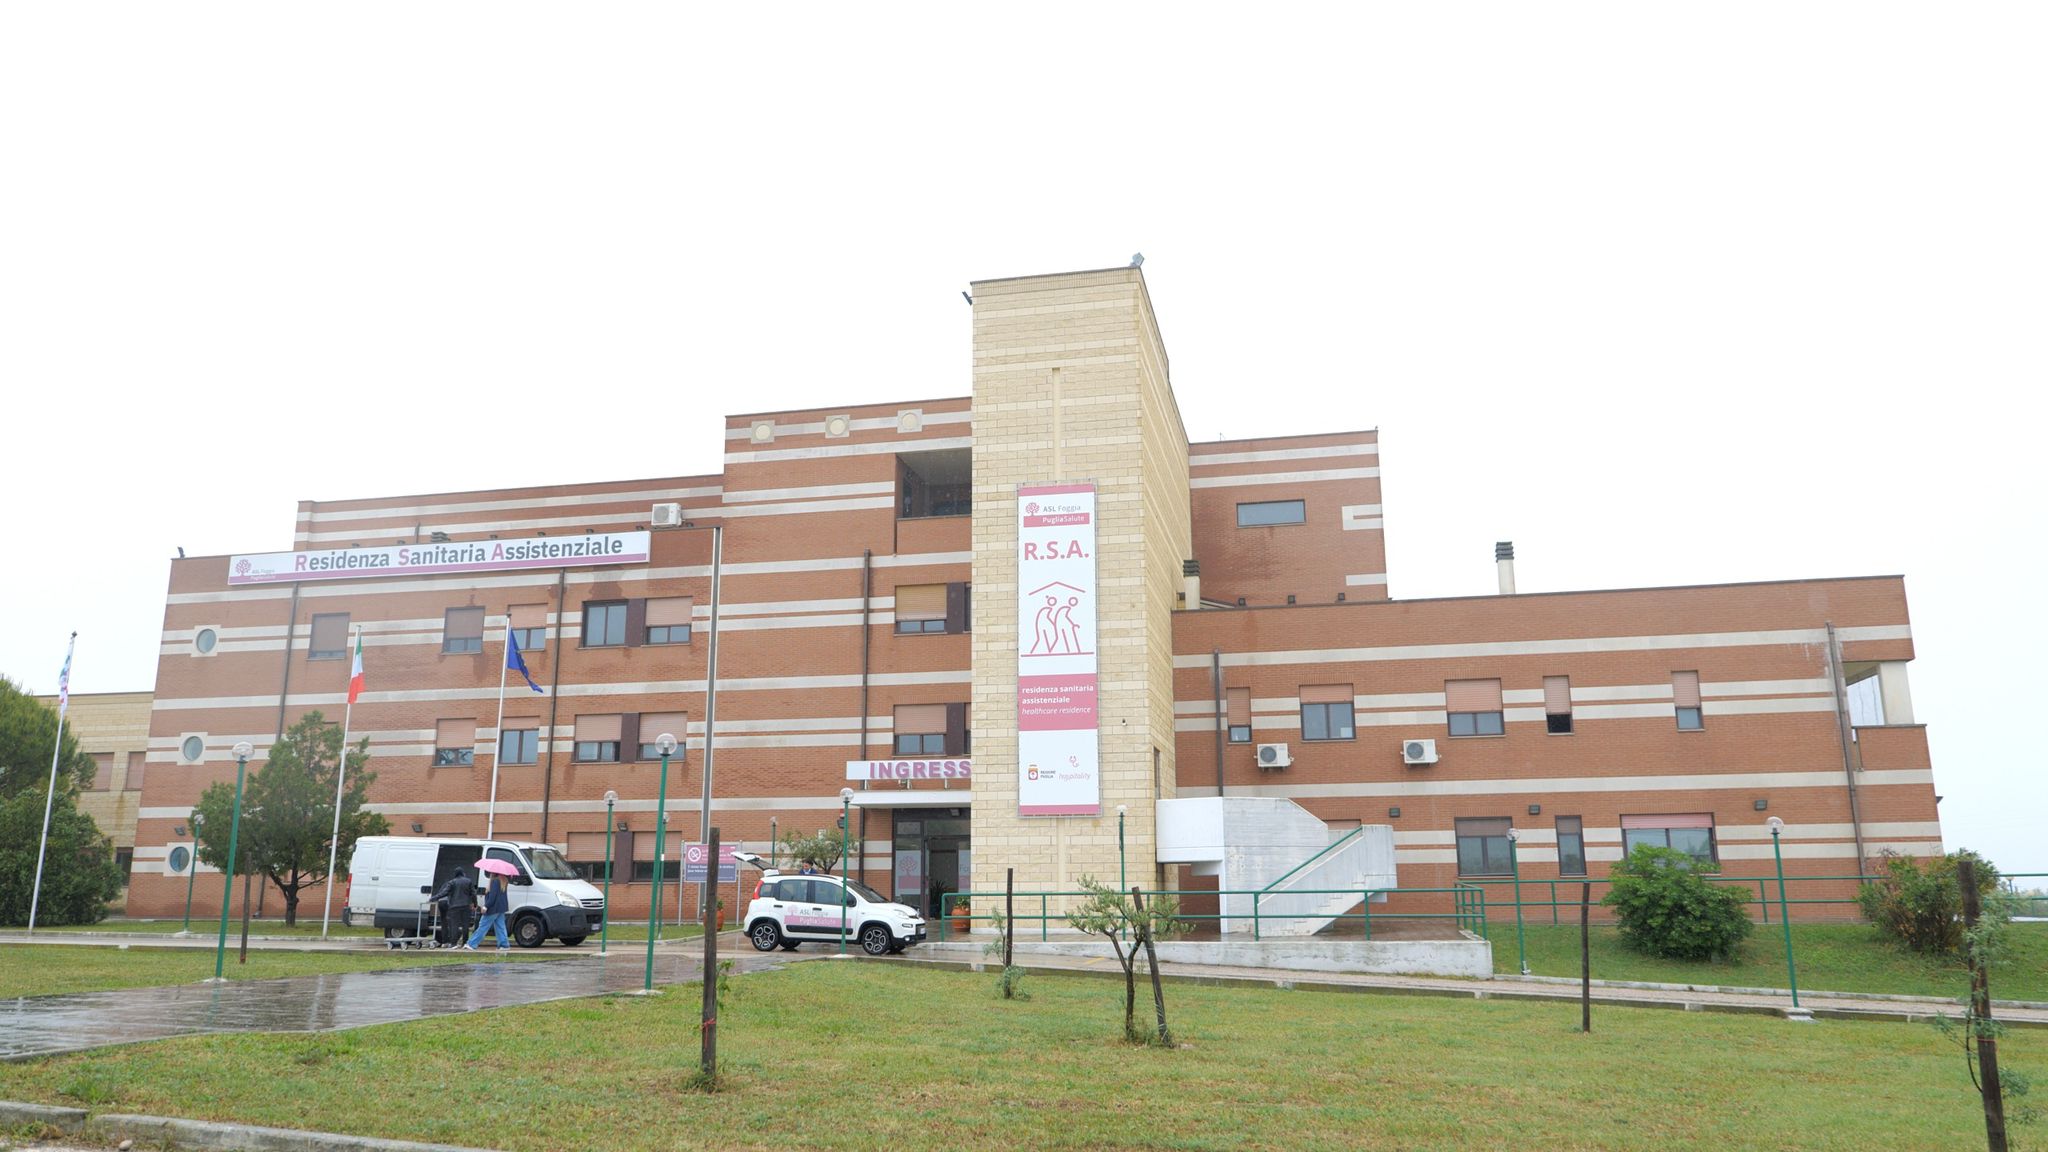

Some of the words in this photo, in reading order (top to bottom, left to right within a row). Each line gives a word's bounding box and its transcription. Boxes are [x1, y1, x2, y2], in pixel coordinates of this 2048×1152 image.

[1058, 505, 1081, 513] Foggia
[1042, 515, 1085, 525] PugliaSalute
[295, 551, 389, 572] Residenza
[398, 544, 486, 566] Sanitaria
[491, 536, 623, 561] Assistenziale
[1024, 540, 1089, 560] R.S.A.
[1022, 686, 1058, 694] residenza
[1060, 684, 1094, 692] sanitaria
[1022, 696, 1071, 704] assistenziale
[1059, 706, 1091, 714] residence
